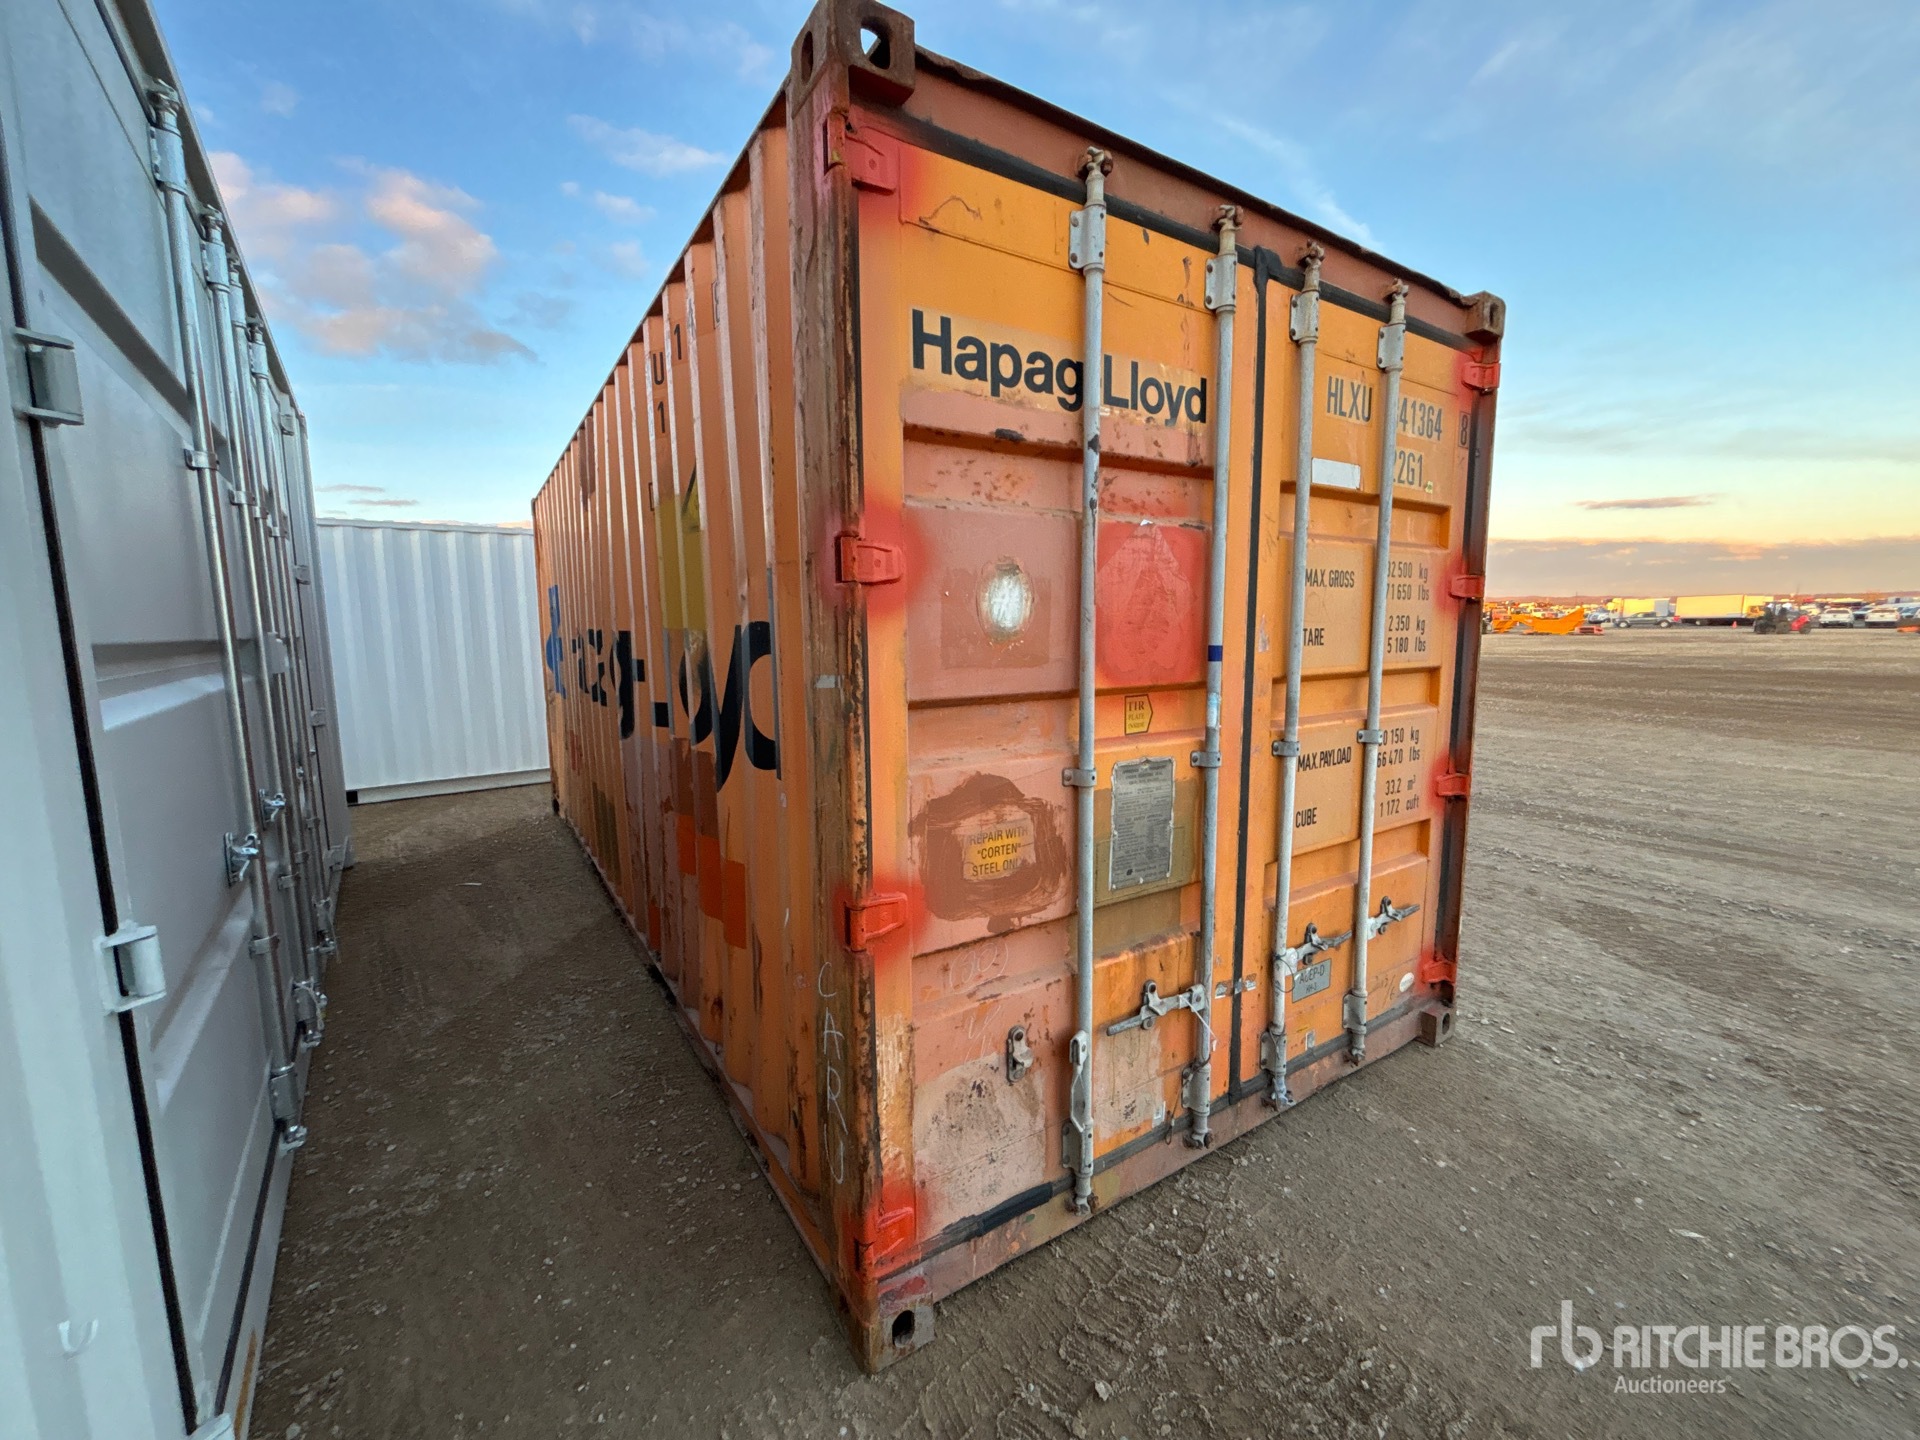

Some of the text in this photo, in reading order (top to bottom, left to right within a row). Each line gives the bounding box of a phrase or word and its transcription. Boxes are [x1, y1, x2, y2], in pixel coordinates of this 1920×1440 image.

[912, 308, 1207, 426] Hapag Lloyd
[1327, 376, 1469, 446] HLXU 41364 8
[1328, 570, 1355, 588] GROSS
[1419, 563, 1428, 583] kg
[1418, 584, 1429, 600] lbs
[1416, 615, 1425, 635] kg
[1303, 628, 1325, 646] TARE
[1414, 637, 1426, 652] lbs
[1128, 701, 1145, 711] TIR
[1411, 726, 1419, 744] kg
[1320, 746, 1352, 768] PAYLOAD
[1409, 746, 1420, 762] lbs
[1296, 807, 1317, 828] CUBE
[969, 826, 1028, 845] REPAIR WITH
[972, 858, 1023, 877] STEEL ONL
